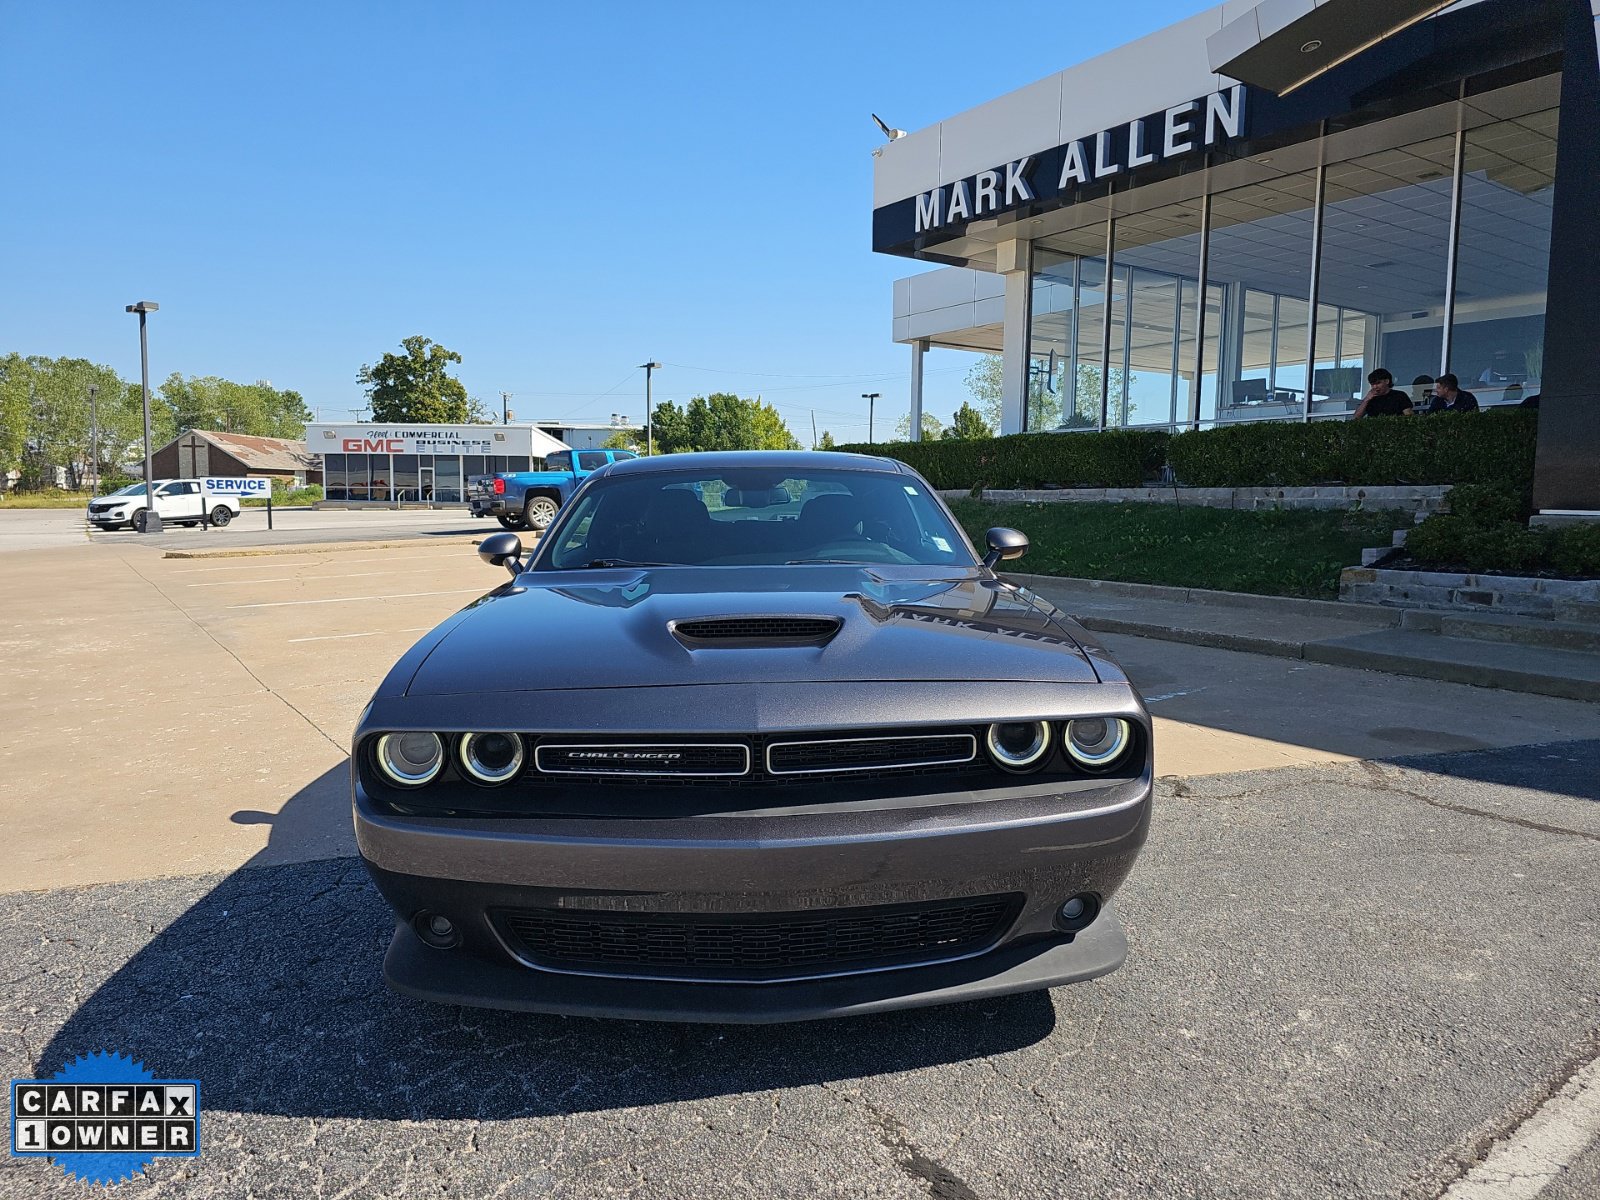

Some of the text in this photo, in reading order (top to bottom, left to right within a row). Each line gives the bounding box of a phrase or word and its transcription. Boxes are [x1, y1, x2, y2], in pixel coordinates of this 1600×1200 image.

[914, 84, 1247, 233] MARK ALLEN
[394, 431, 462, 439] COMMERCIAL
[342, 439, 404, 453] GMC
[415, 445, 492, 453] ELITE
[206, 479, 266, 490] SERVICE
